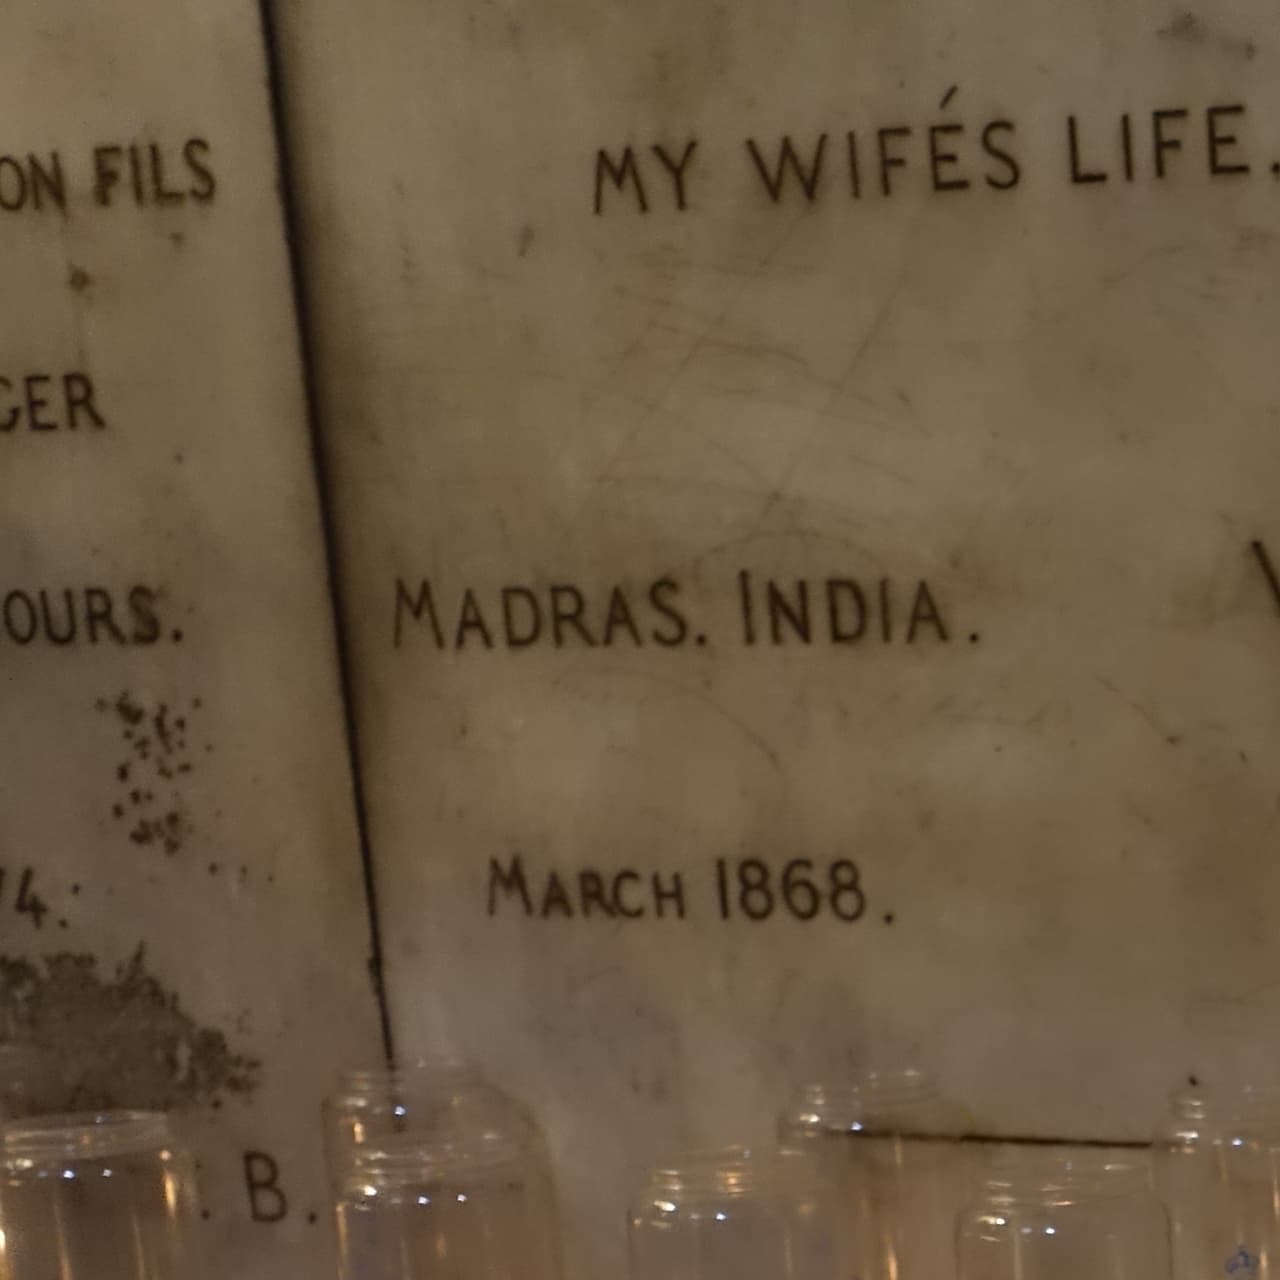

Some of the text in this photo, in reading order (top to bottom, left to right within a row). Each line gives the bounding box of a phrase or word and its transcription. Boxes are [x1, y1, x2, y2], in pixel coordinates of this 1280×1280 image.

[92, 137, 217, 211] FILS
[594, 139, 698, 215] MY
[0, 865, 67, 930] 4.
[715, 856, 894, 925] 1868.
